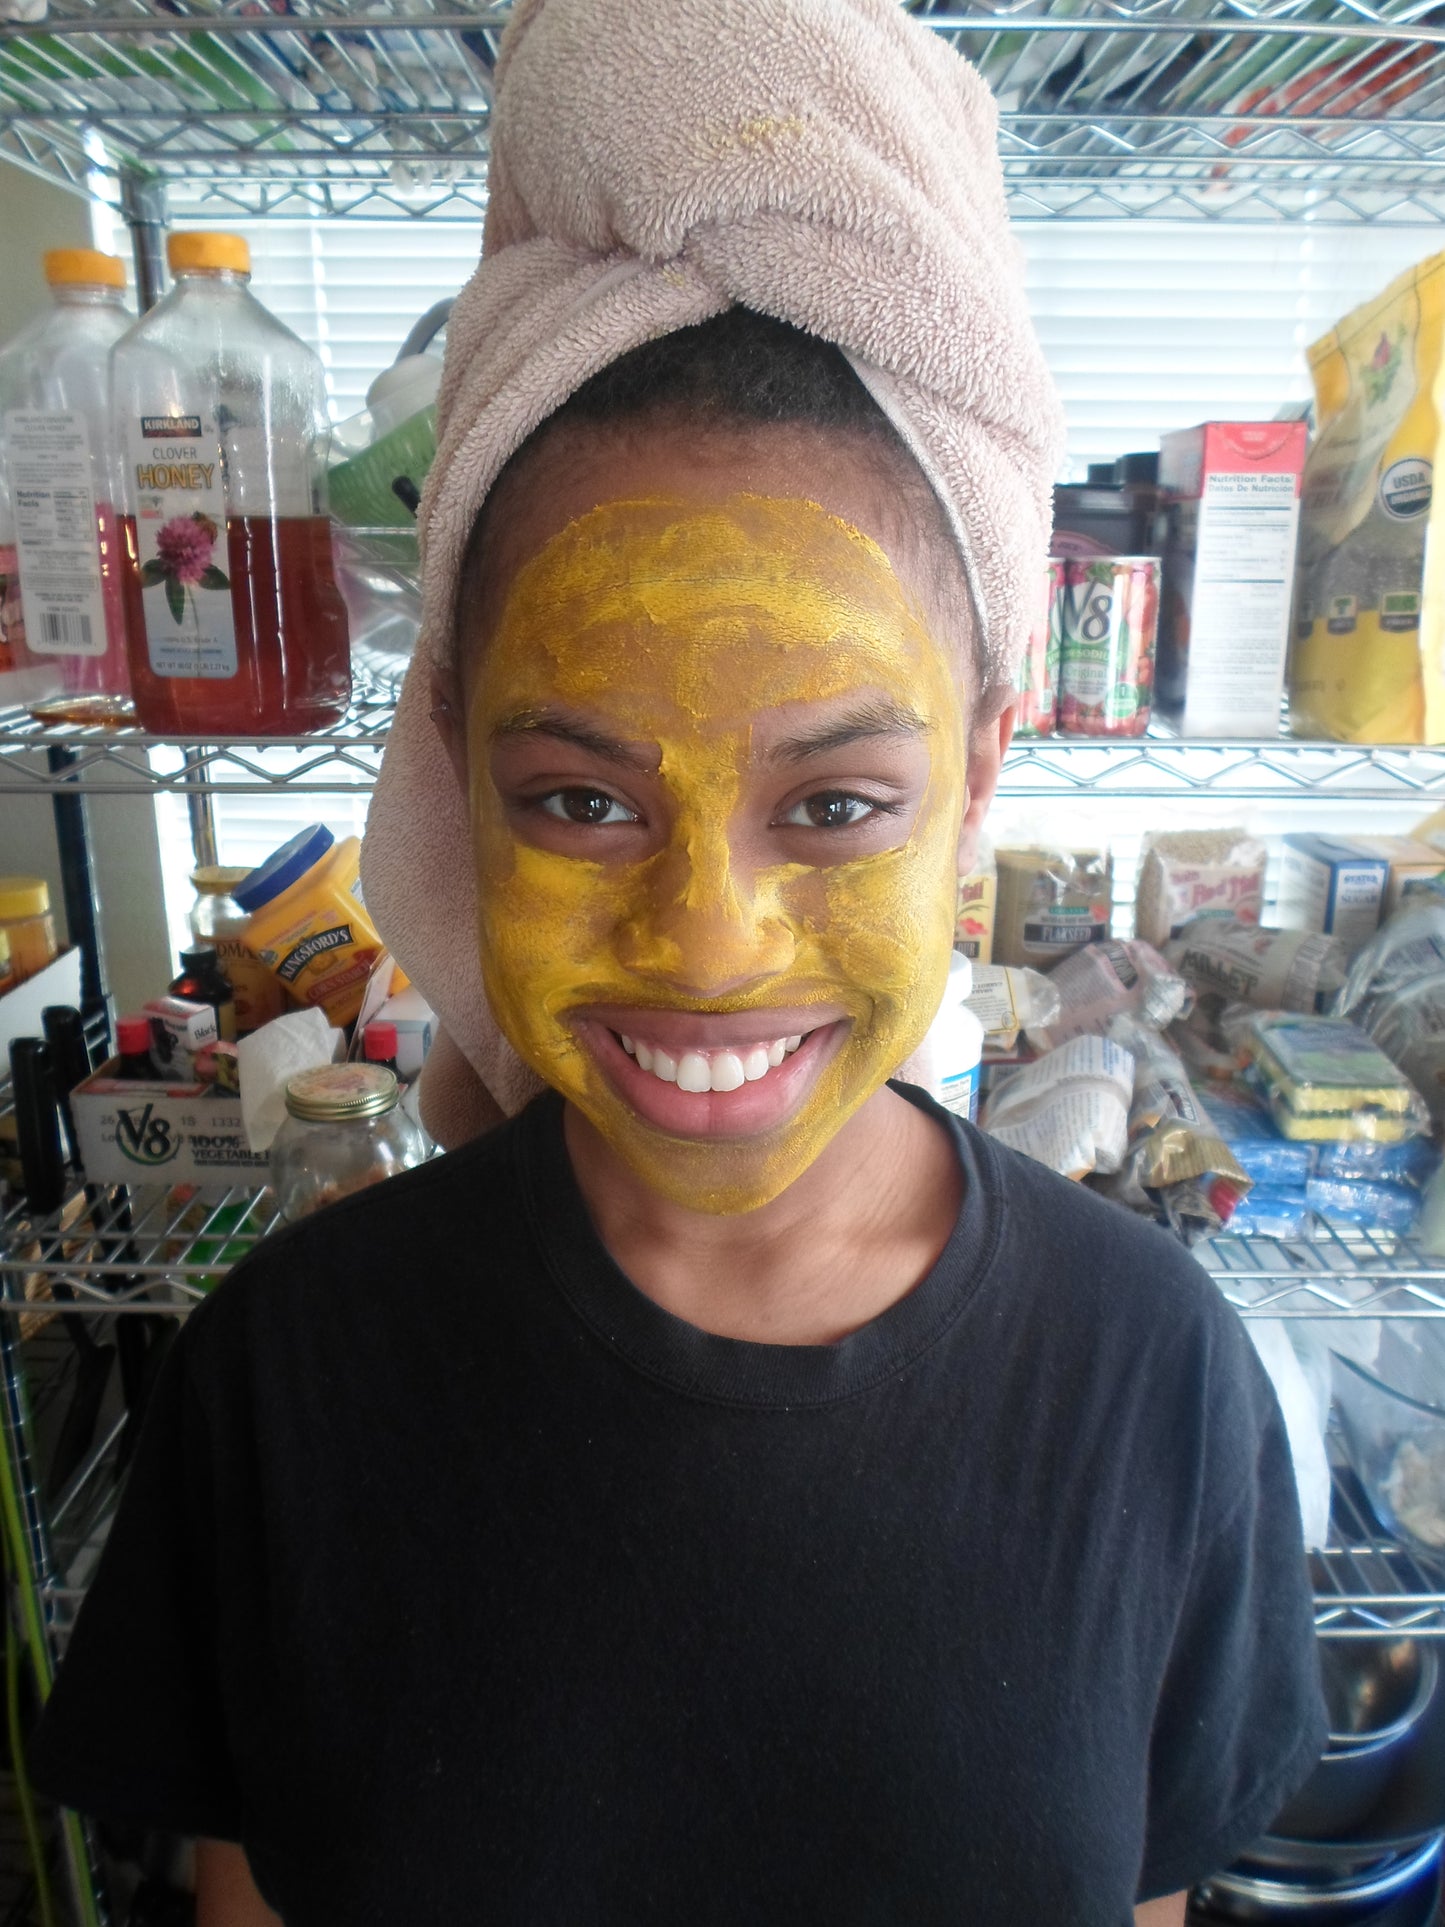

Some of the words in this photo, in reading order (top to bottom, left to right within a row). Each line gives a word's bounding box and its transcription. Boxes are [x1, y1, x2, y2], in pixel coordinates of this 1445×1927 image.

[143, 418, 200, 431] KIRKLAND
[152, 447, 198, 460] CLOVER
[136, 463, 215, 490] HONEY
[1208, 474, 1257, 483] Nutrition
[1393, 472, 1426, 488] USDA
[16, 490, 51, 498] Nutrition
[1208, 484, 1234, 493] Datos
[1236, 484, 1248, 493] De
[17, 499, 40, 508] Facts
[1066, 576, 1113, 641] V8
[1042, 925, 1091, 942] FLAXSEED
[280, 928, 350, 978] KINGSFORD'S
[1180, 949, 1259, 995] MILLET
[194, 1024, 218, 1041] Black
[117, 1103, 171, 1158] V8
[191, 1135, 240, 1149] 100%
[192, 1149, 262, 1160] VEGETABLE
